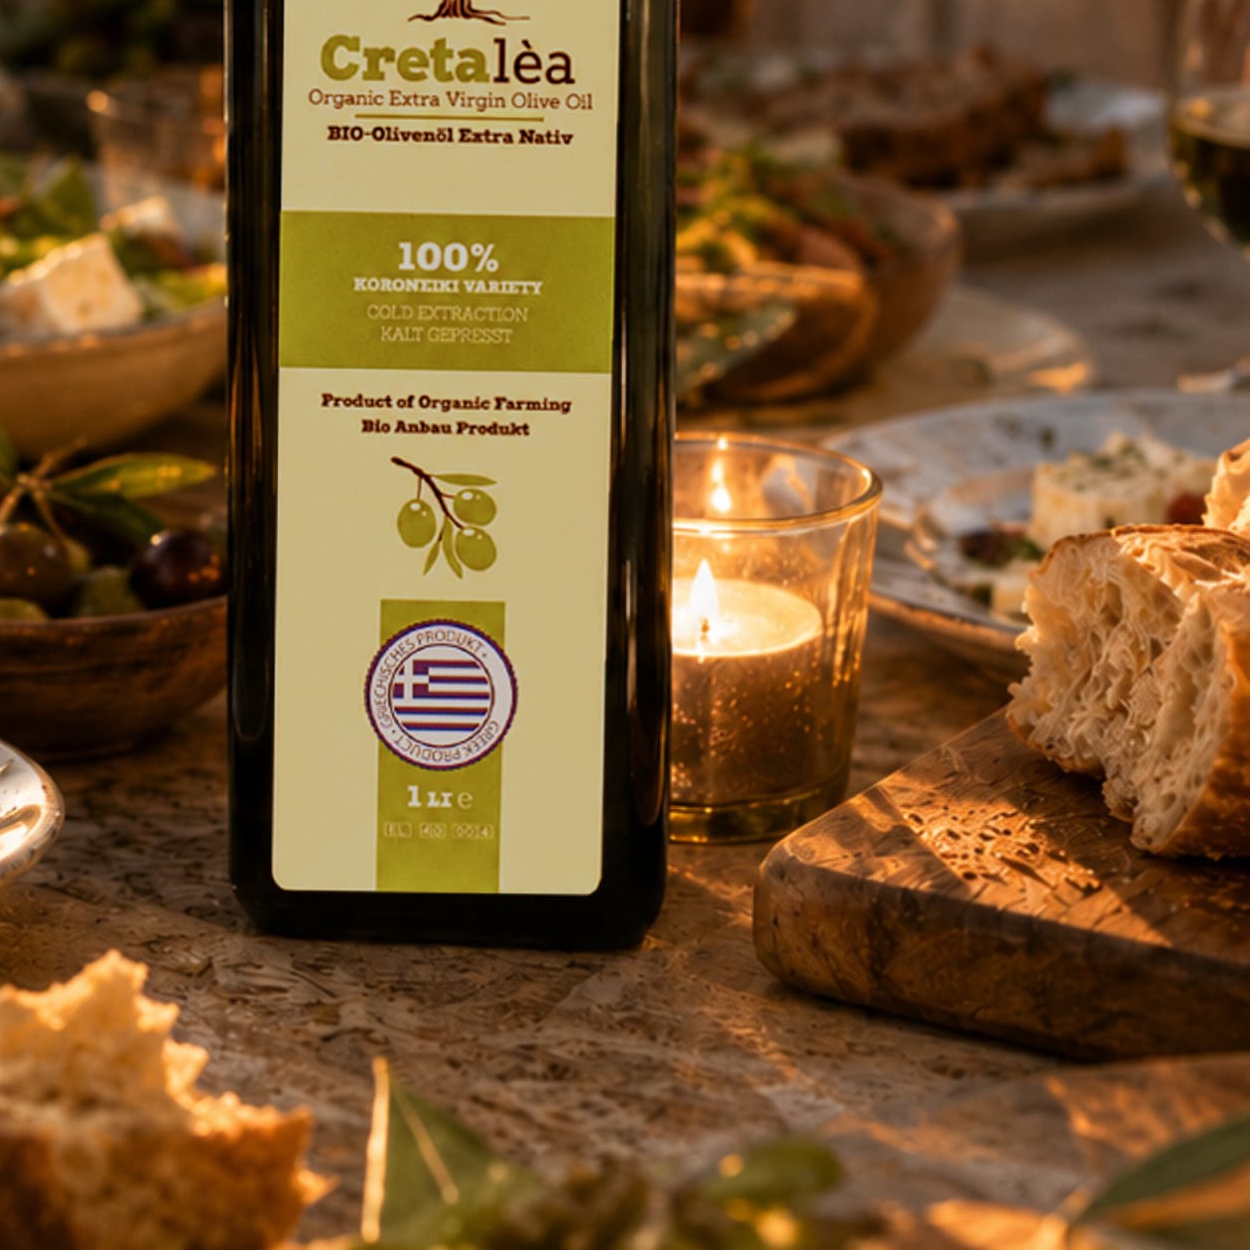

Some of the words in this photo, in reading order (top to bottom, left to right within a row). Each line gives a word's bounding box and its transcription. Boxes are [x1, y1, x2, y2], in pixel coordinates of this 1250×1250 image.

[320, 34, 575, 84] Cretalèa
[308, 88, 384, 109] Organic
[389, 90, 440, 107] Extra
[446, 91, 506, 112] Virgin
[512, 92, 560, 110] Olive
[565, 93, 593, 110] Oil
[327, 125, 454, 143] BIO-Olivenöl
[458, 128, 514, 144] Extra
[518, 129, 574, 145] Nativ
[398, 242, 499, 272] 100%
[353, 277, 460, 293] KORONEIKI
[463, 280, 543, 295] VARIETY
[367, 304, 413, 320] COLD
[418, 305, 529, 322] EXTRACTION
[381, 326, 424, 341] KALT
[428, 327, 513, 344] GEPRESST
[321, 393, 393, 409] Product
[396, 394, 415, 409] of
[418, 395, 490, 413] Organic
[494, 396, 572, 414] Farming
[361, 419, 391, 434] Bio
[394, 420, 452, 435] Anbau
[456, 421, 530, 436] Produkt
[416, 629, 484, 653] PRODUKT
[394, 734, 461, 762] PRODUCT
[462, 720, 499, 756] GREEK
[407, 785, 422, 807] 1
